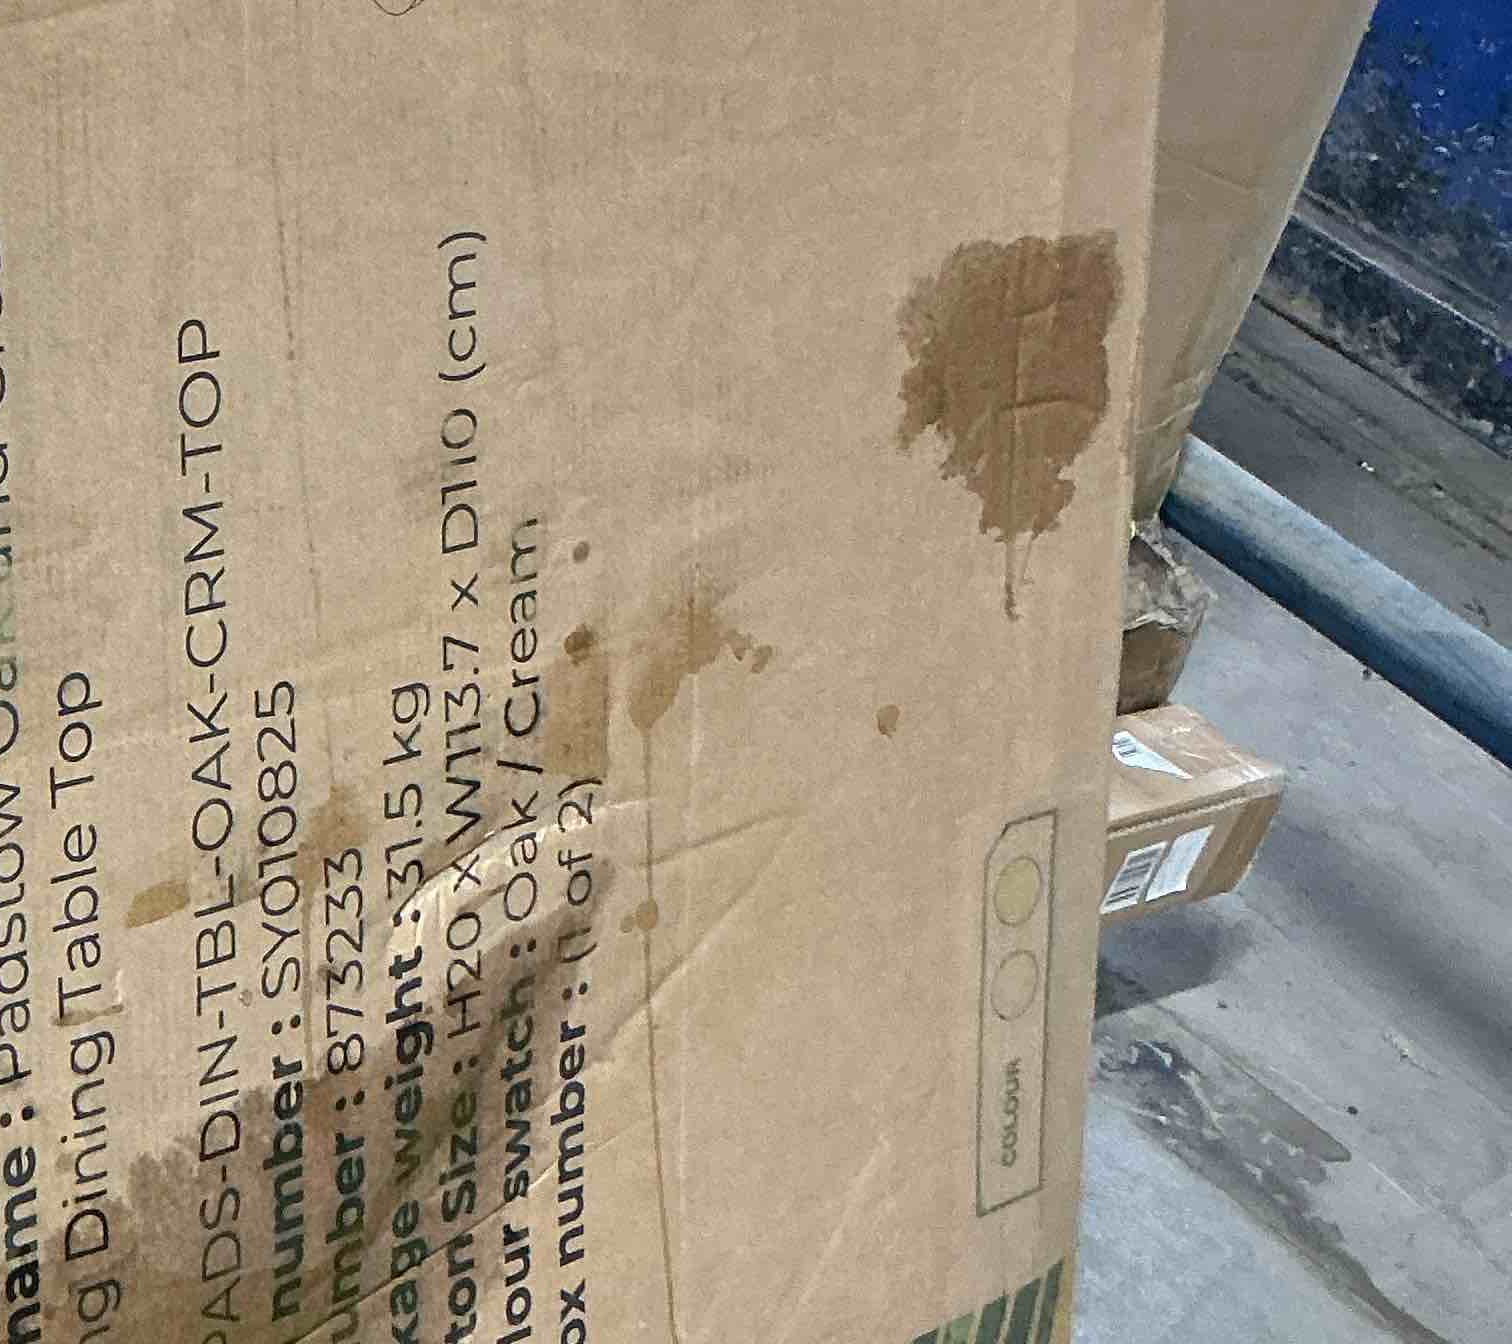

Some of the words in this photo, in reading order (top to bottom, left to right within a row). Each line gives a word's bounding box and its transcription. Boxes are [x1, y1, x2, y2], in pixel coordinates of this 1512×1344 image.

[437, 230, 487, 382] (cm)
[440, 407, 479, 555] D110
[451, 572, 479, 612] x
[503, 517, 540, 738] Cream
[49, 671, 103, 809] Top
[382, 681, 431, 768] kg
[442, 634, 483, 846] W113.7
[253, 680, 302, 1000] SY010825
[383, 783, 424, 900] 31.5
[500, 790, 539, 922] Oak
[557, 775, 603, 834] 2)
[558, 848, 594, 907] of
[50, 822, 102, 1020] Table
[322, 846, 366, 1076] 873233
[445, 911, 482, 1039] H20
[383, 944, 434, 1183] weight
[500, 975, 536, 1203] swatch
[997, 1055, 1022, 1168] COLOUR
[60, 1029, 116, 1261] Dining
[262, 1055, 304, 1323] number
[439, 1089, 478, 1224] Size
[550, 1019, 588, 1268] number
